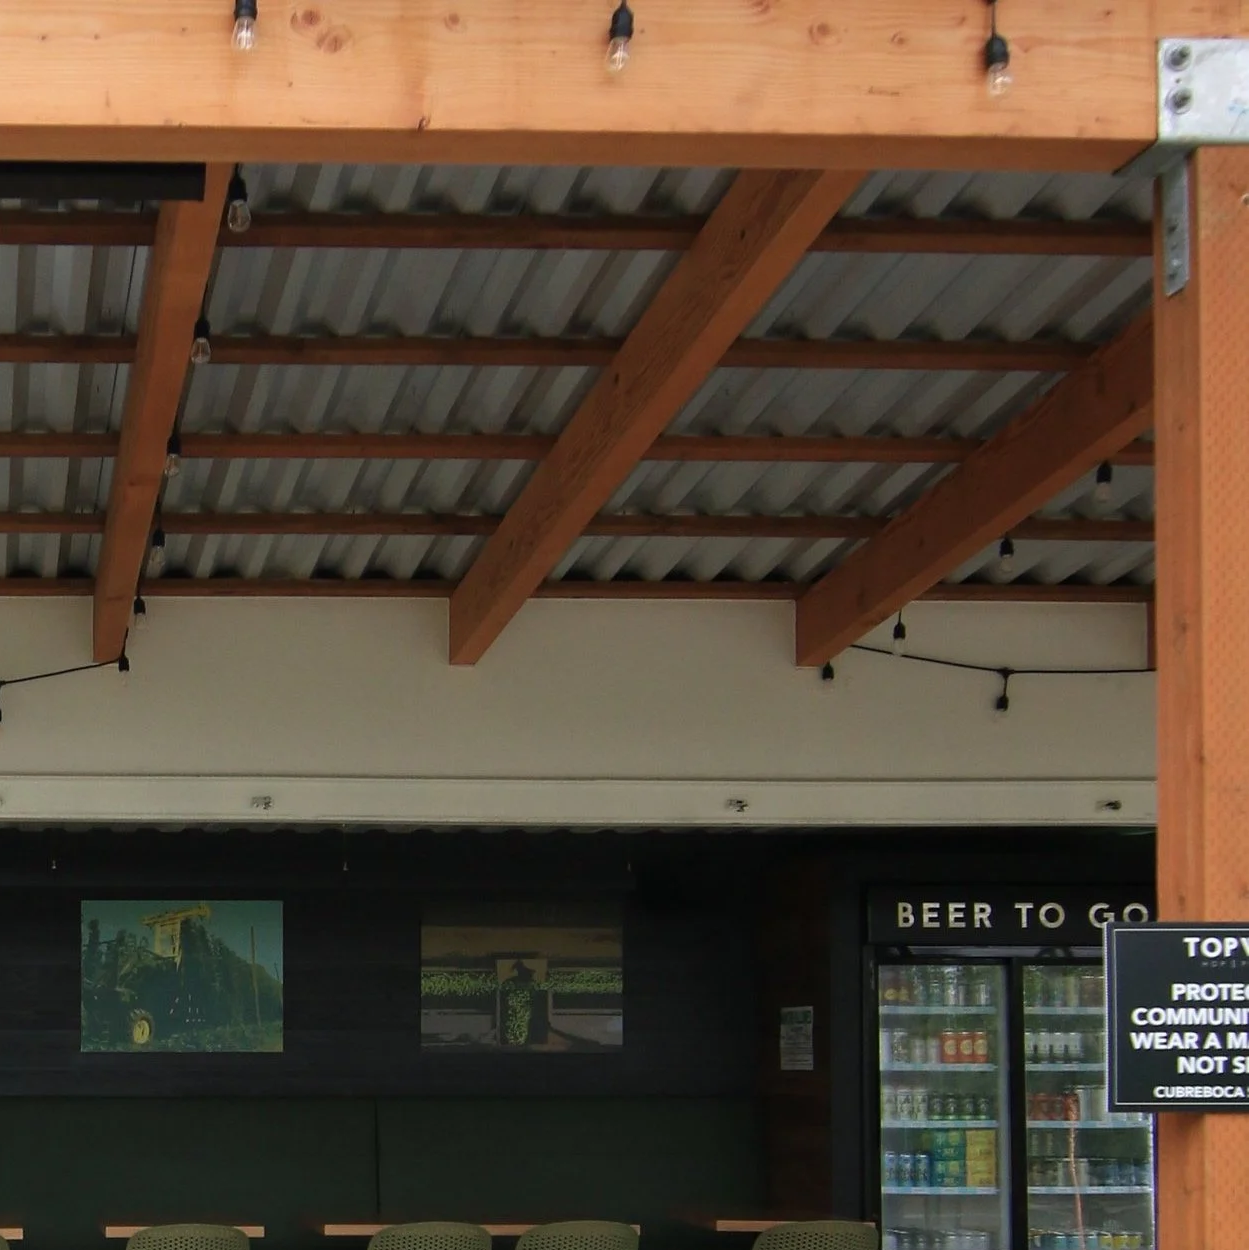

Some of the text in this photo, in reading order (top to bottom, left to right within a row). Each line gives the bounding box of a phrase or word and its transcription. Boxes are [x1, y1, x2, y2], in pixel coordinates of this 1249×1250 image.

[897, 902, 1149, 929] BEER TO GO
[1131, 1007, 1249, 1026] COMMUNI
[1130, 1031, 1249, 1049] WEAR A M
[1177, 1056, 1228, 1074] NOT
[1153, 1086, 1246, 1098] CUBREBOCA
